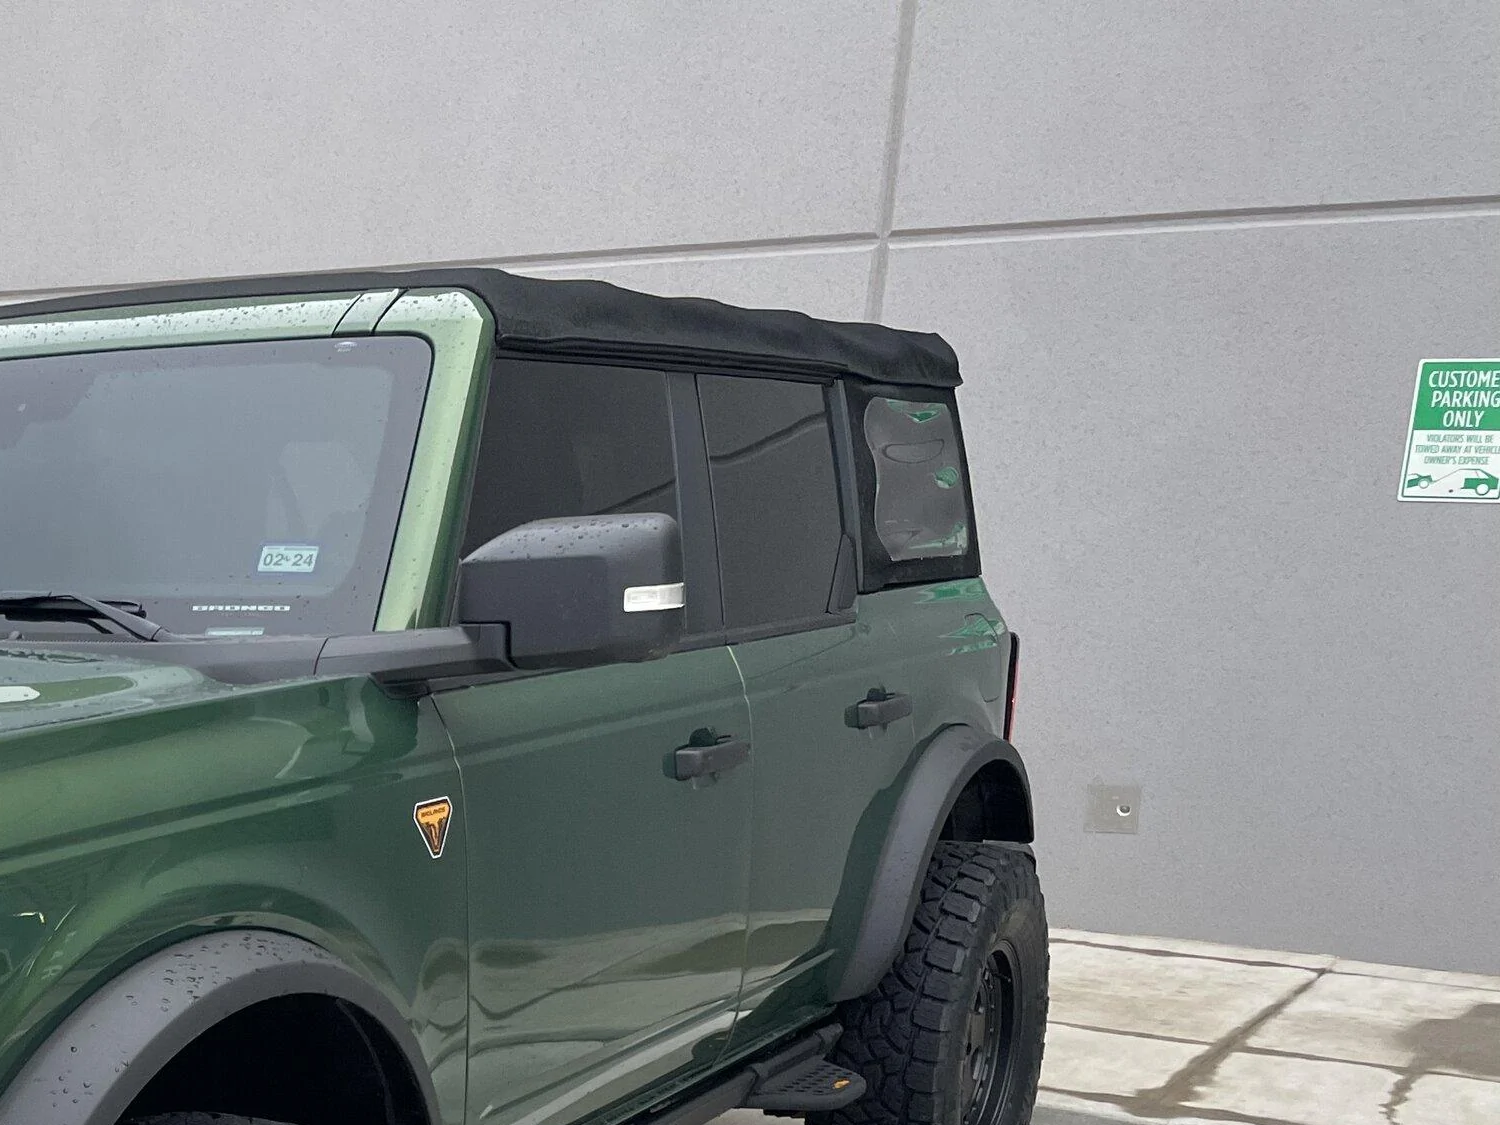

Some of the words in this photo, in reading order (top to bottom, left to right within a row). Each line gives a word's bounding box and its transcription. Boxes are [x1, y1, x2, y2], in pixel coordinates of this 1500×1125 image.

[1430, 390, 1500, 408] PARKING
[1442, 410, 1485, 428] ONLY
[1426, 434, 1464, 444] VIOLATORS
[1466, 434, 1482, 444] WILL
[1484, 434, 1494, 444] BE
[1415, 445, 1440, 454] TOWED
[1441, 445, 1463, 454] AWAY
[1464, 445, 1474, 455] AT
[1423, 456, 1456, 465] OWNER'S
[1457, 456, 1490, 465] EXPENSE
